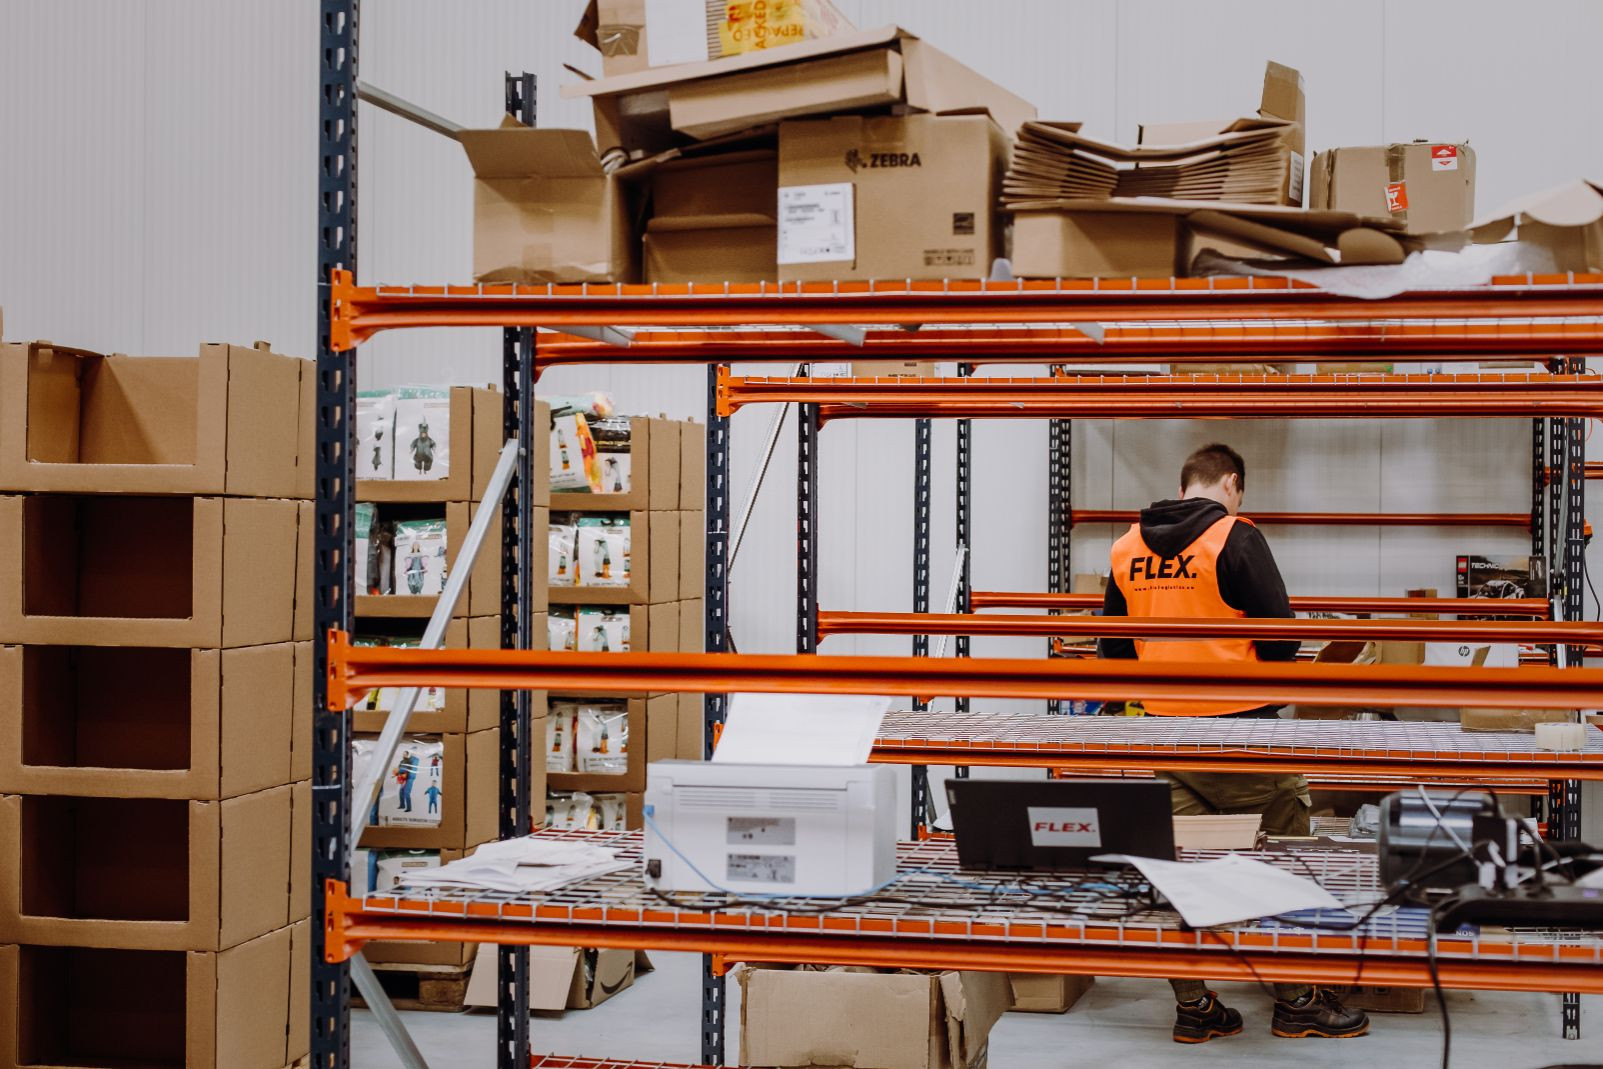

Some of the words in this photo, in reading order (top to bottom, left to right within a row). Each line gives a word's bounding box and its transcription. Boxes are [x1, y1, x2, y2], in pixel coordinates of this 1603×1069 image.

[870, 152, 921, 168] ZEBRA
[1129, 554, 1197, 581] FLEX.
[1034, 821, 1097, 833] FLEX.
